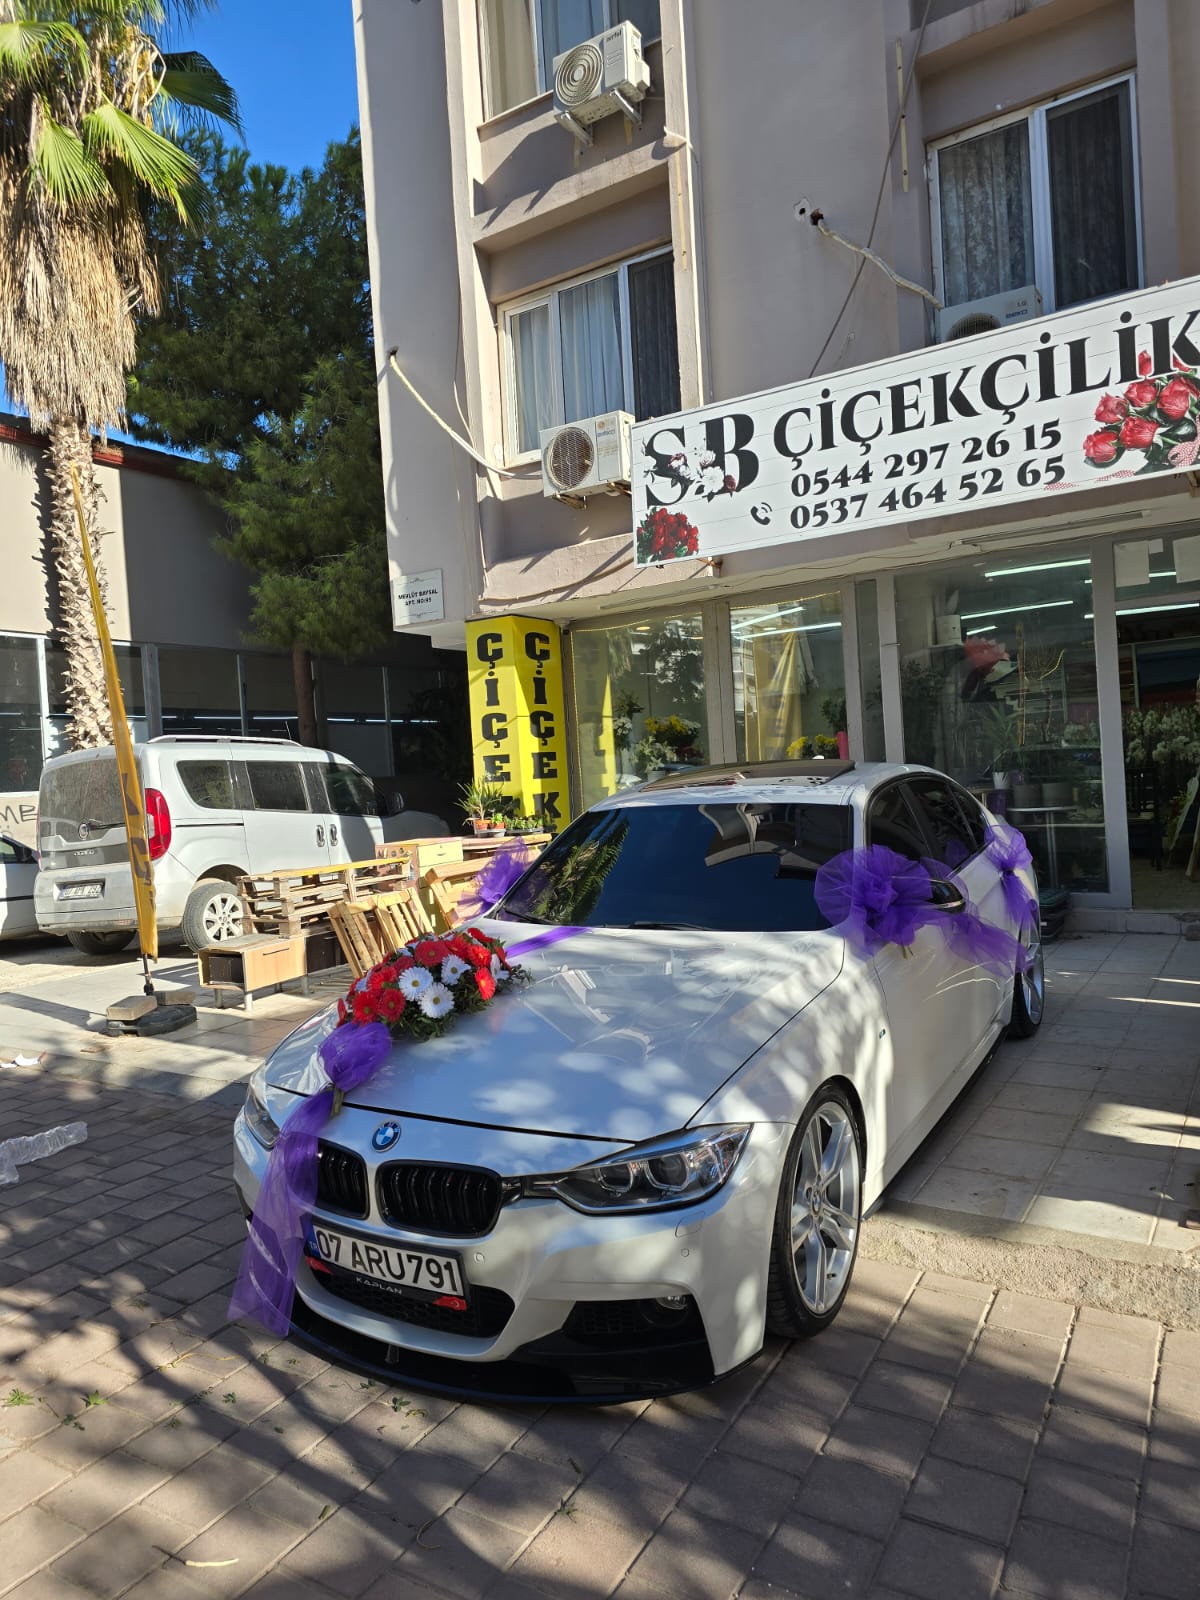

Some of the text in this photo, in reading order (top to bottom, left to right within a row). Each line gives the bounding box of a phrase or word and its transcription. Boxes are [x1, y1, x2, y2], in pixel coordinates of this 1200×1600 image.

[773, 310, 1200, 470] ÇİÇEKÇİLİK
[790, 453, 1066, 529] 0537 464 52 65
[791, 418, 1061, 497] 0544 297 26 15
[476, 632, 514, 814] ÇİÇE
[525, 631, 562, 820] ÇİÇEK
[316, 1230, 342, 1262] 07
